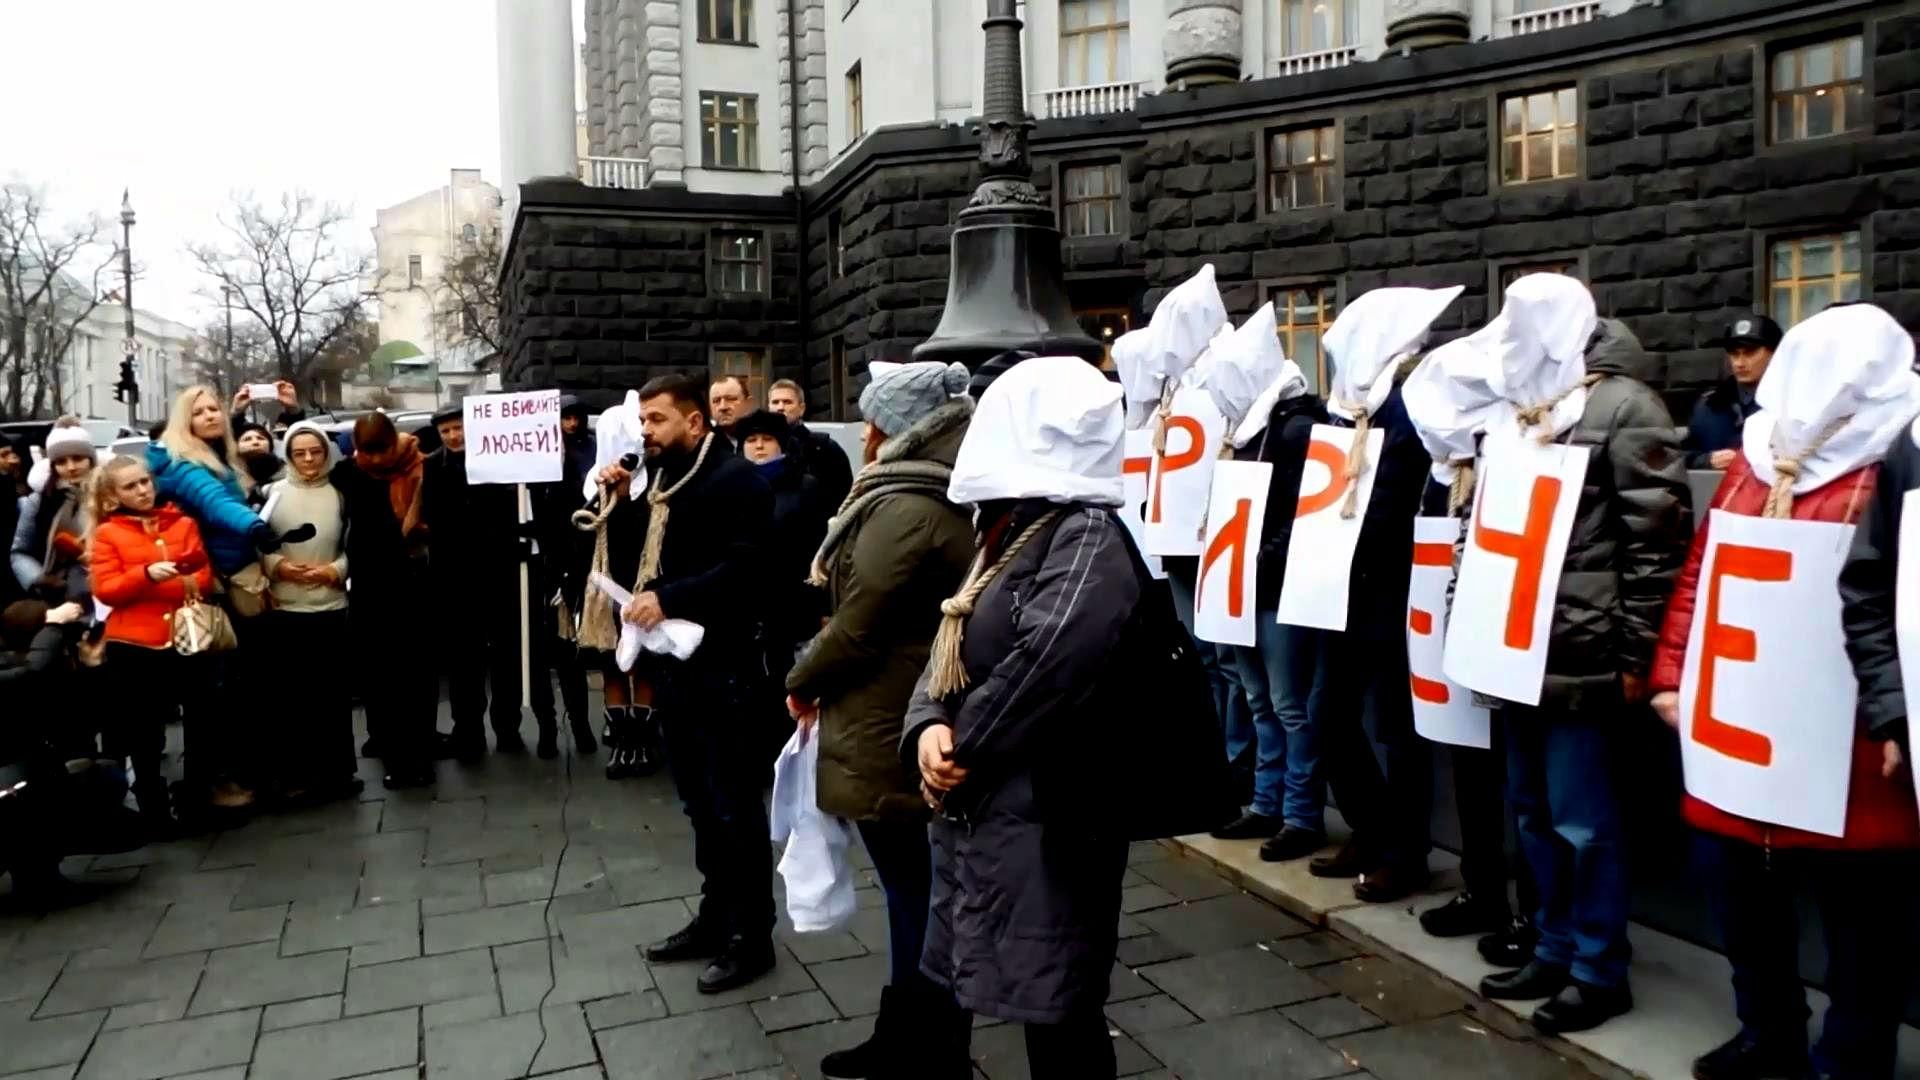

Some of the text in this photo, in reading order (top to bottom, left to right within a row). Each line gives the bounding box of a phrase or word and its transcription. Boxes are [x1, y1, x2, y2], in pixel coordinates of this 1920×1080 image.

[473, 403, 492, 419] НЕ
[476, 423, 559, 456] ЛЮДЕЙ!
[1475, 475, 1562, 651] Ч
[1692, 542, 1792, 767] Е
